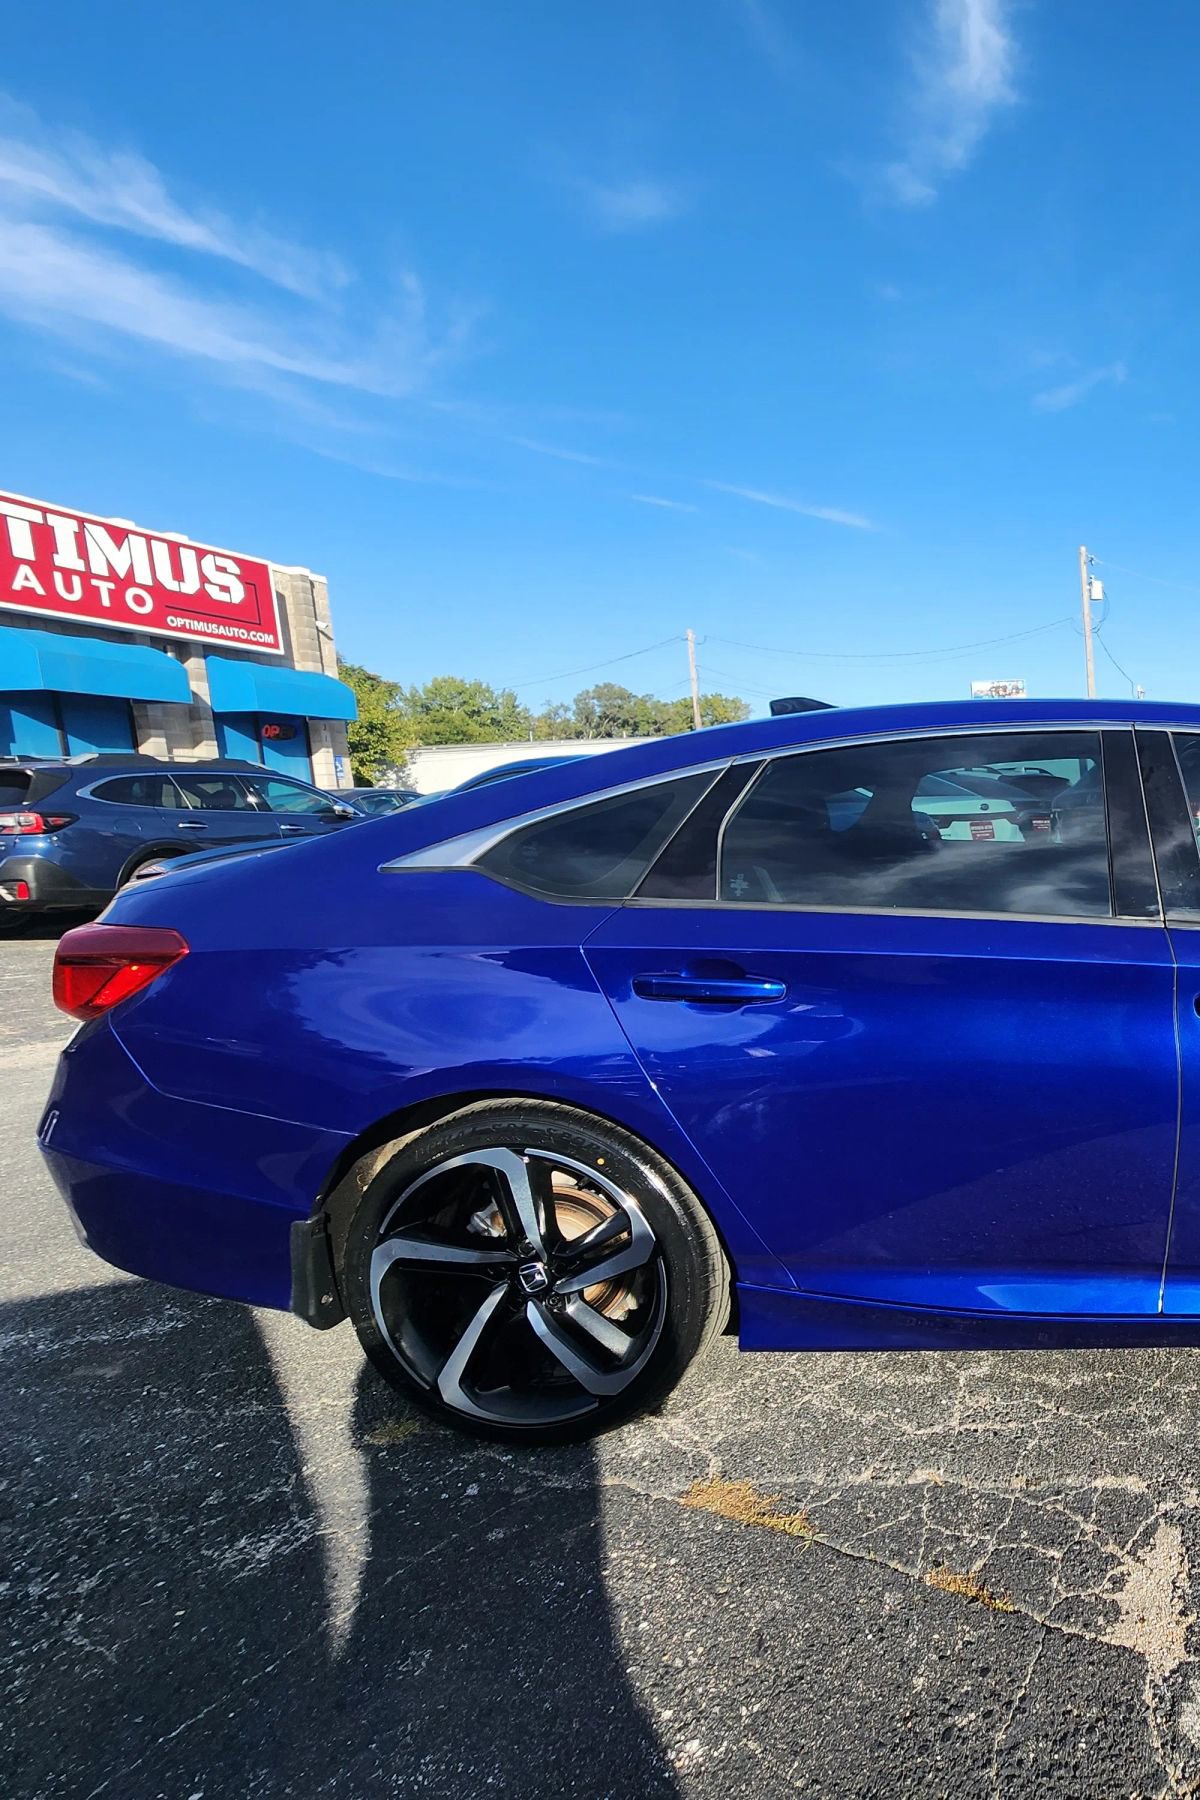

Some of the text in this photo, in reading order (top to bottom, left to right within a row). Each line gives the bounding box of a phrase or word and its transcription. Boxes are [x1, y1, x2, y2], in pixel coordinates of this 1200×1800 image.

[0, 501, 245, 604] TIMUS
[11, 564, 153, 614] AUTO
[166, 616, 275, 644] OPTIMUSAUTO.COM
